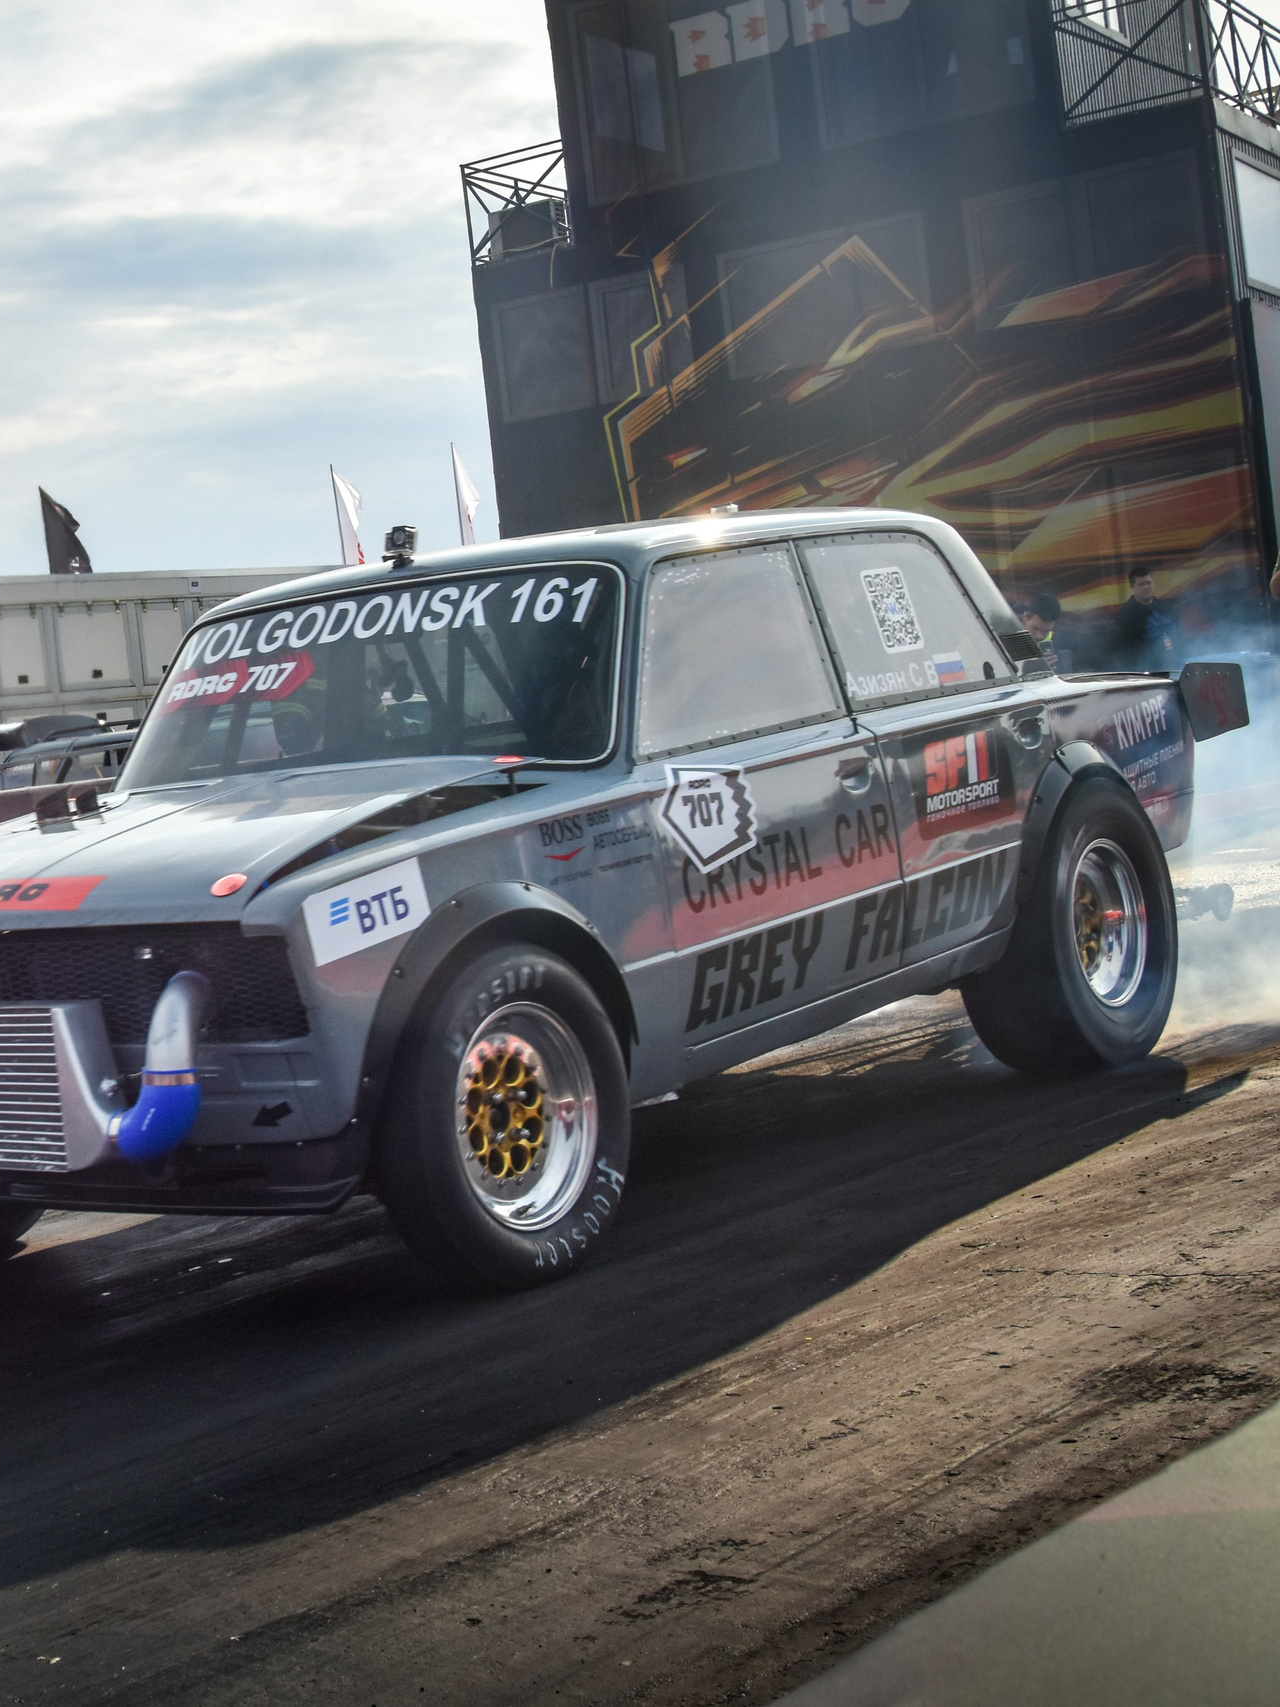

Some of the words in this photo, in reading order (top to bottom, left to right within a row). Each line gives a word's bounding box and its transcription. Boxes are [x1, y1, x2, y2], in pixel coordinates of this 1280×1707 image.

[183, 582, 501, 671] VOLGODONSK
[511, 576, 598, 624] 161
[165, 672, 239, 704] RDRC
[238, 661, 298, 693] 707
[846, 669, 909, 697] Азизян
[1113, 704, 1146, 751] KVM
[1141, 694, 1167, 739] PPF
[1120, 751, 1159, 779] АЩИТНЫЕ
[1137, 771, 1157, 791] АВТО
[681, 791, 725, 829] 707
[926, 778, 1000, 814] MOTORSPORT
[538, 814, 584, 848] BOSS
[682, 826, 824, 914] CRYSTAL
[834, 803, 895, 868] CAR
[354, 885, 410, 934] ВТБ
[683, 910, 825, 1034] GREY
[843, 849, 1007, 973] FALCON
